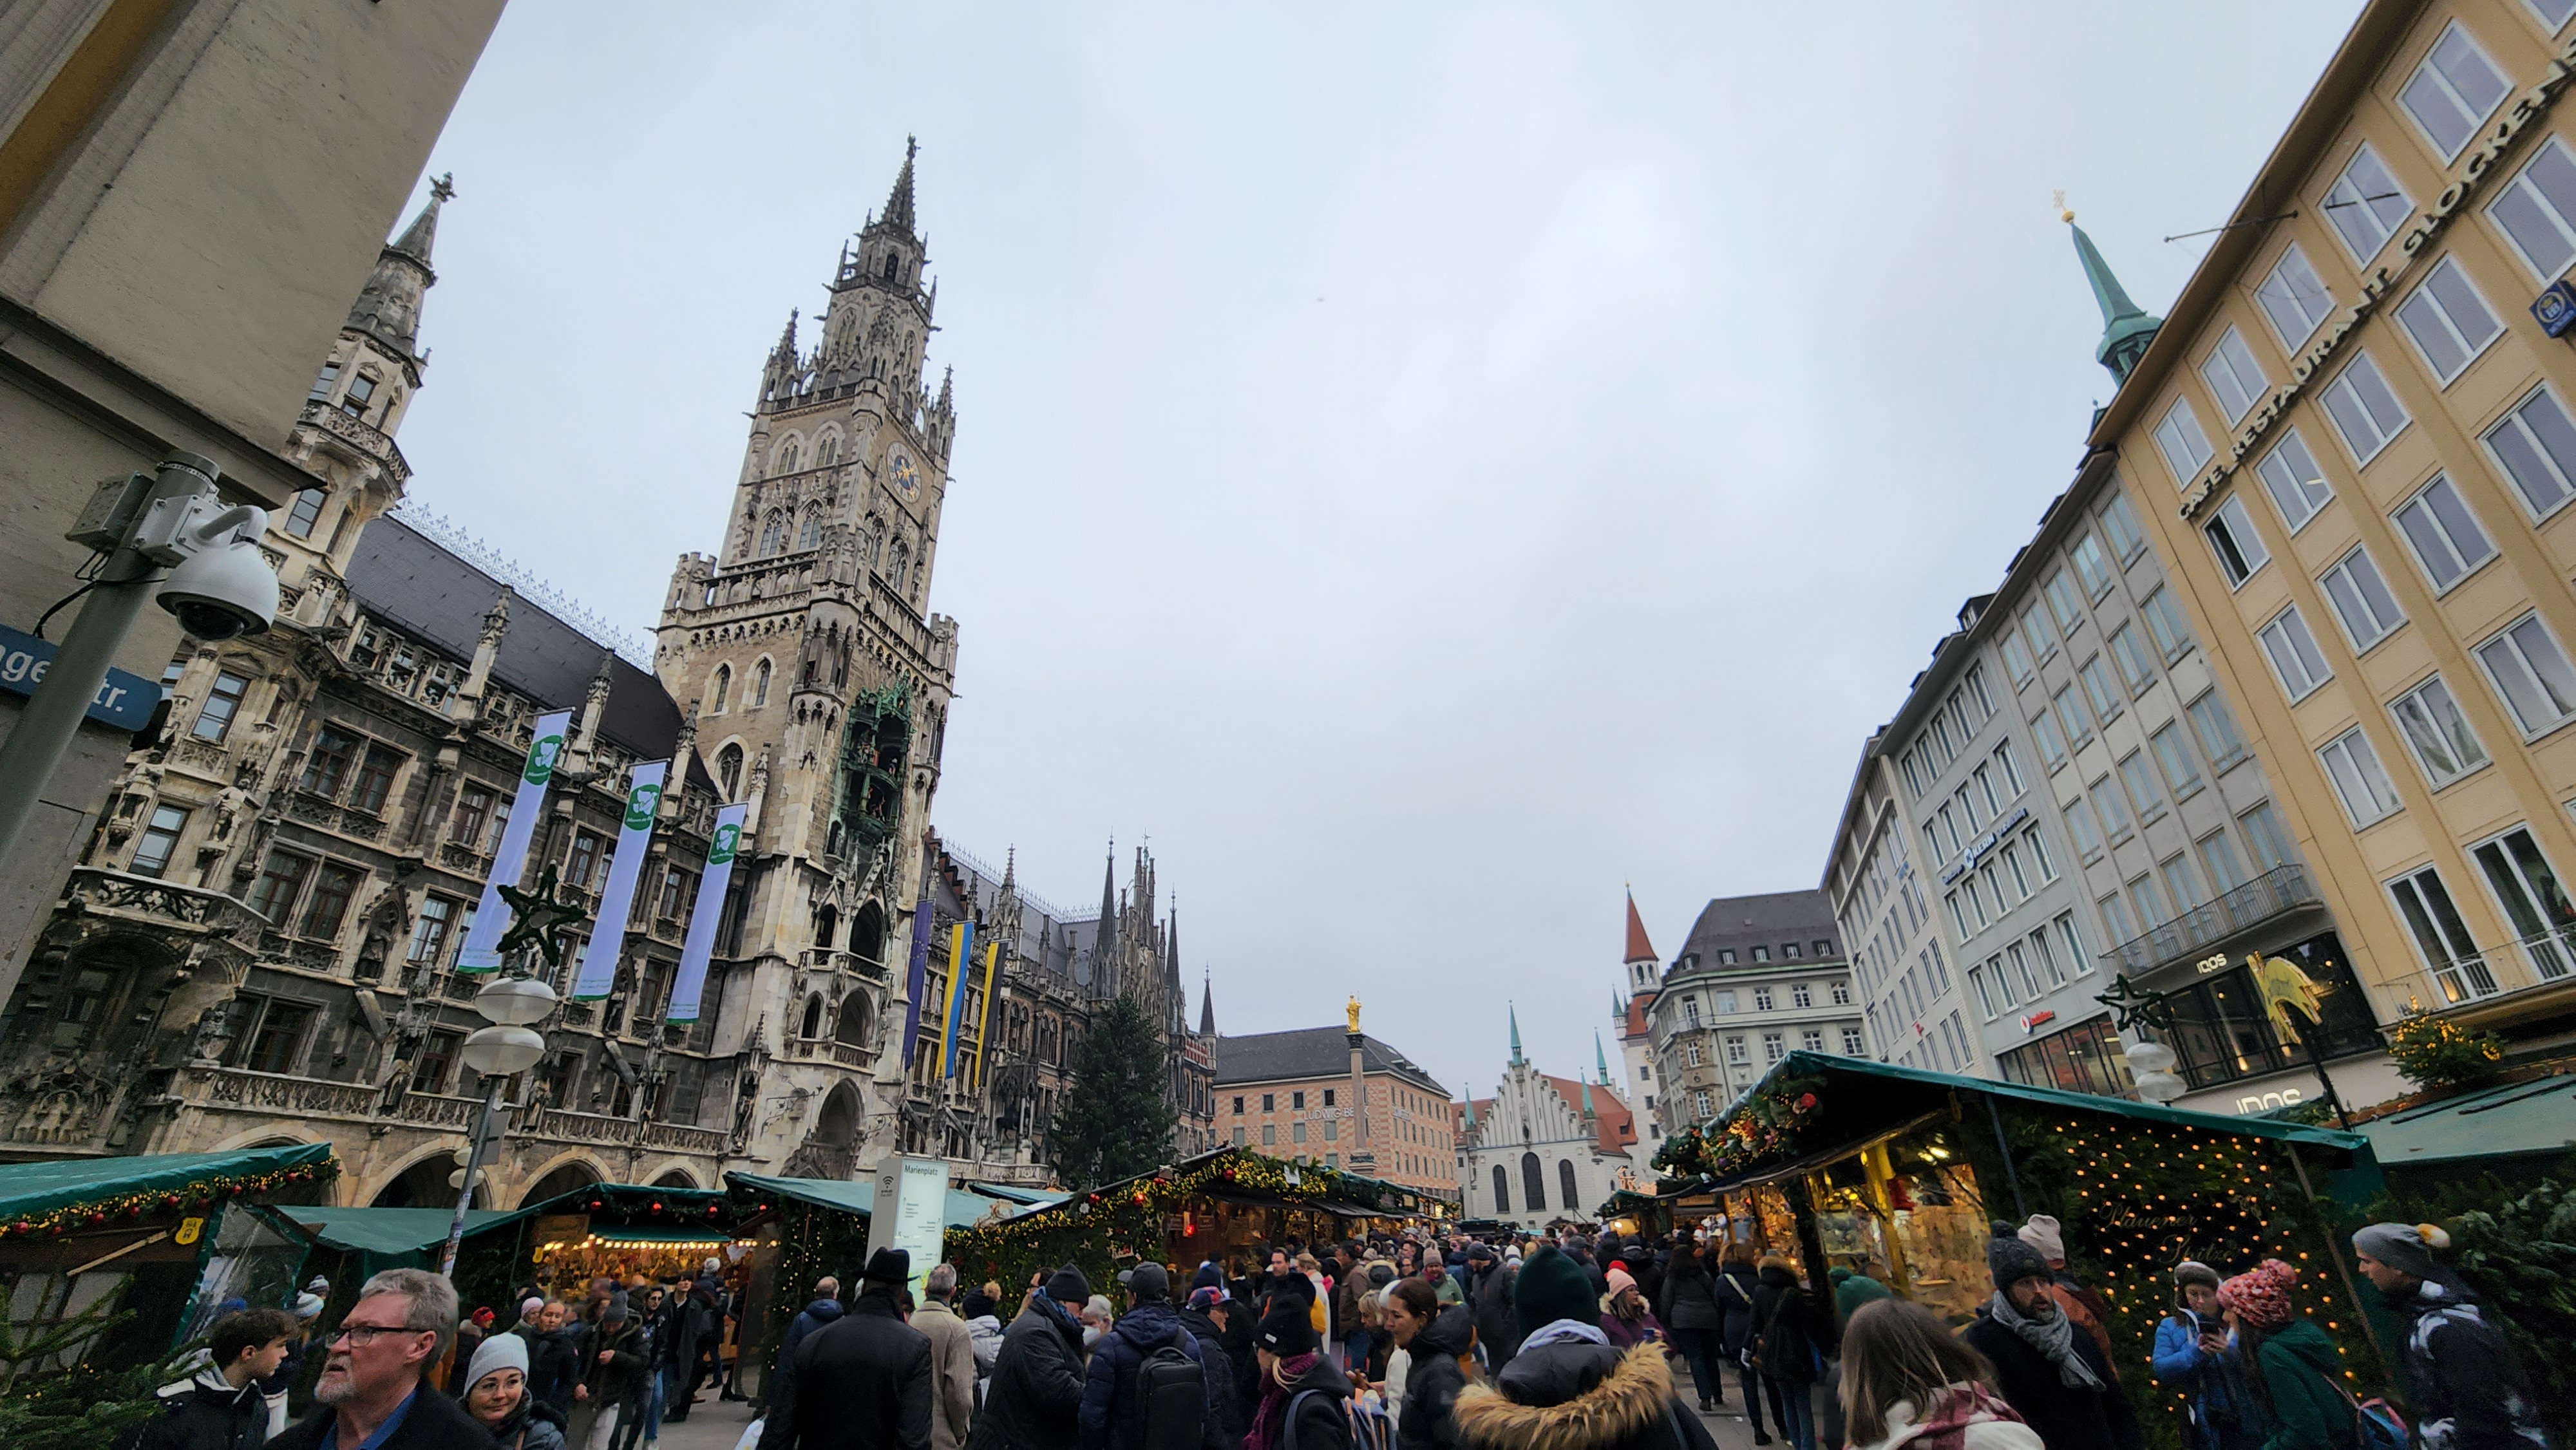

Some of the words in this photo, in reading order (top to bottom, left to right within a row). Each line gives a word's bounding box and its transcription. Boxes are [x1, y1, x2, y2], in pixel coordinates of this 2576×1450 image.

[2228, 268, 2387, 462] RESTAURANT
[1974, 832, 1996, 858] KERN
[2197, 953, 2227, 974] IQOS
[1303, 1108, 1341, 1121] LUDWIG
[1343, 1106, 1370, 1118] BEK
[904, 1164, 938, 1176] Marienplatz
